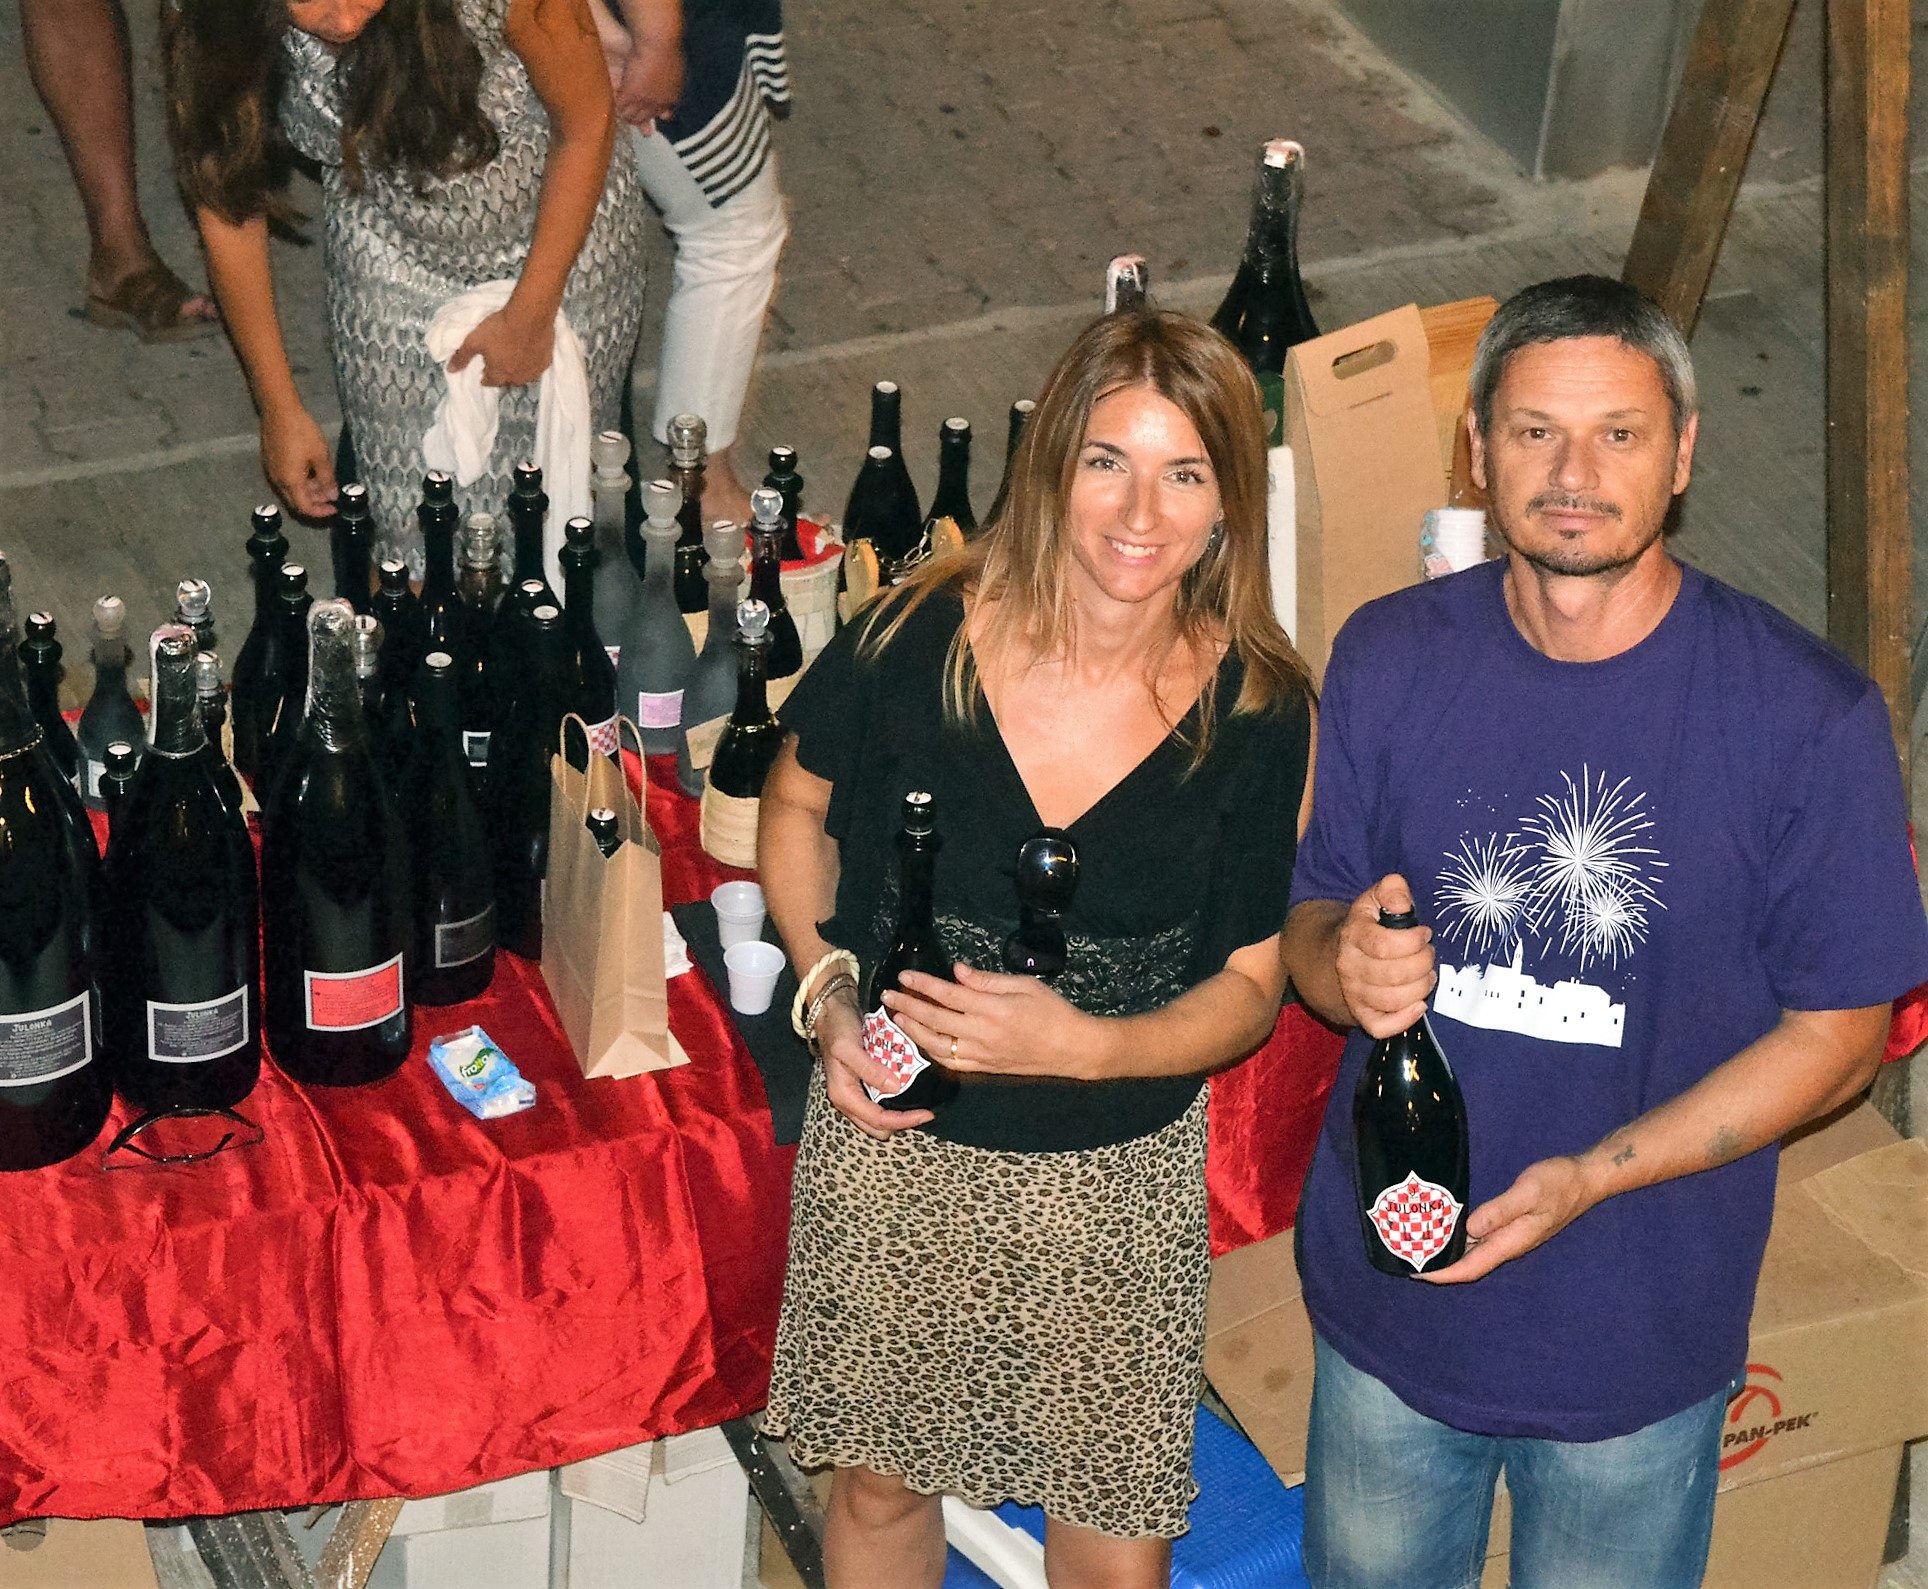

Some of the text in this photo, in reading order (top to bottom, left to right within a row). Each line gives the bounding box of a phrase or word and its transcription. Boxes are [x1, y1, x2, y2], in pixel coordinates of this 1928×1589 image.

[12, 1019, 52, 1032] JULONKA
[1385, 1199, 1445, 1215] JULONKA
[1723, 1412, 1815, 1448] PAN-PEK
